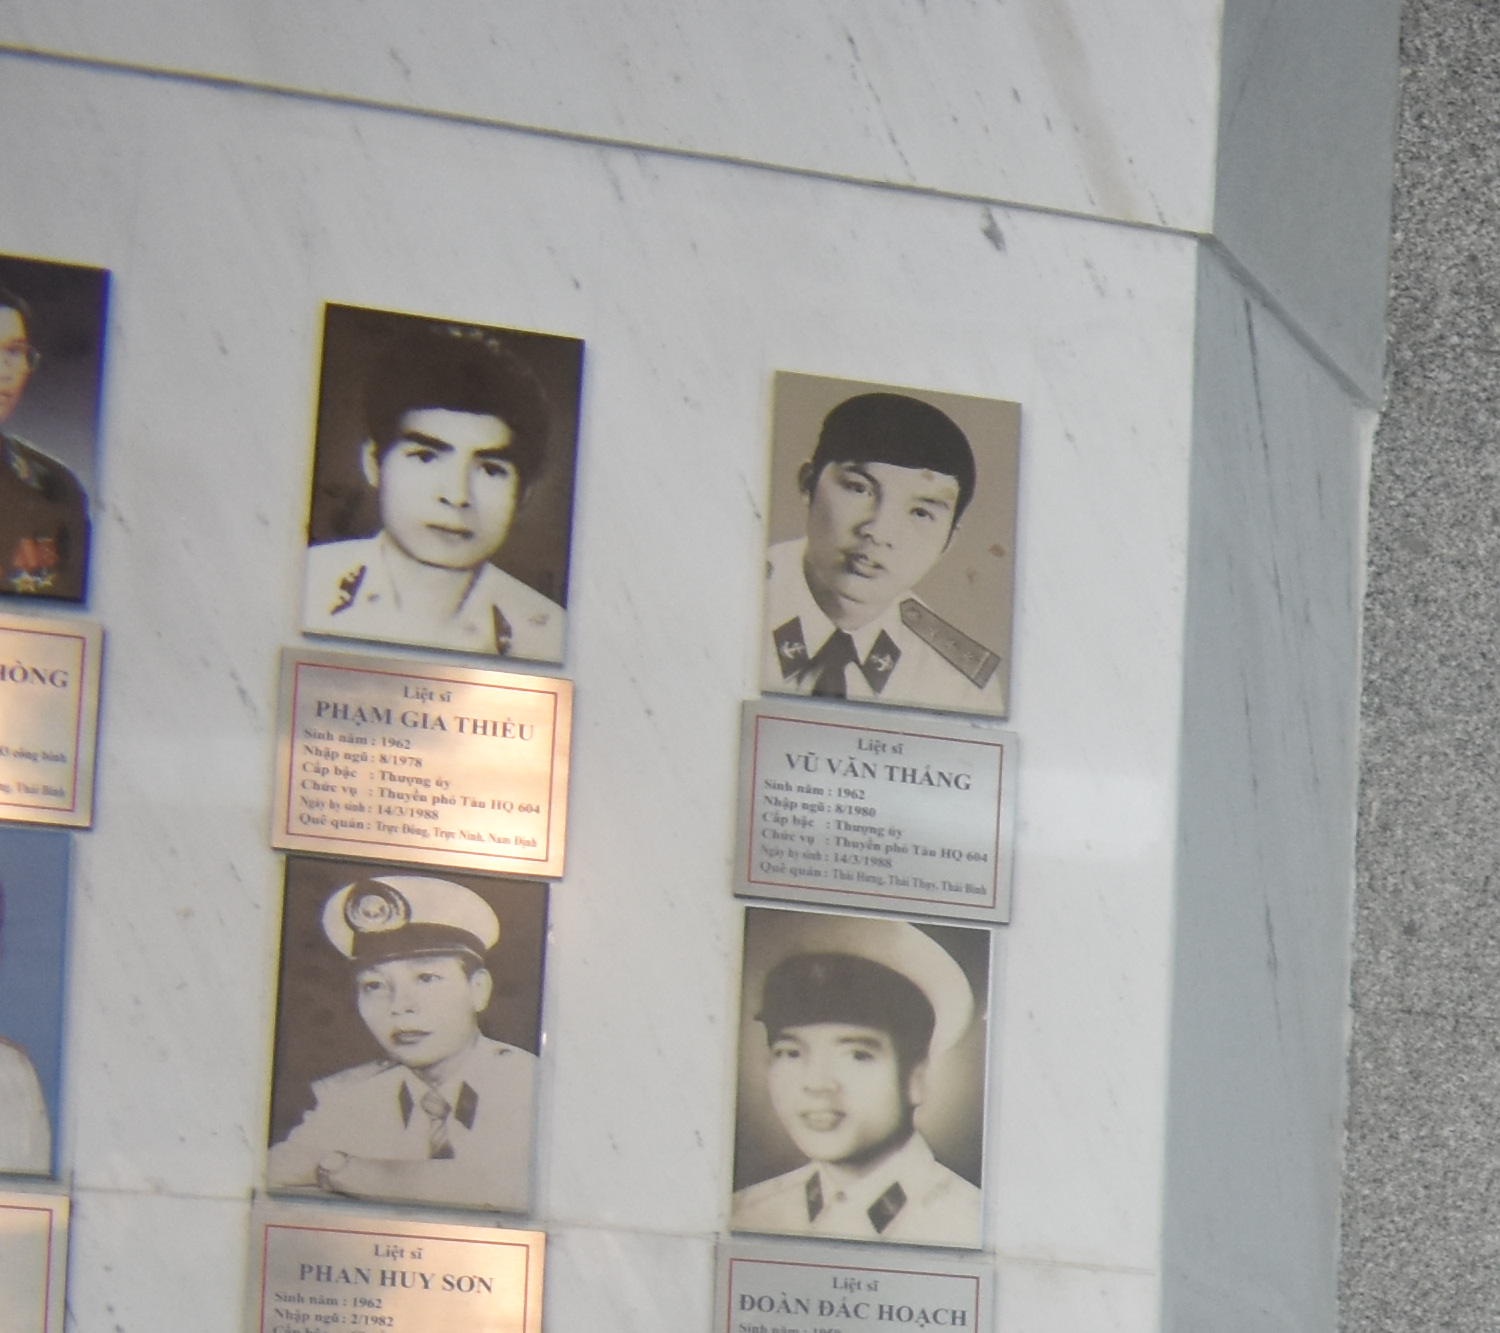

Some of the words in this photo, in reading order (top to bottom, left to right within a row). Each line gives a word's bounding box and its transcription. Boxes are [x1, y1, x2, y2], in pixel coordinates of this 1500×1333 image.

[404, 685, 433, 702] Liệt
[439, 691, 452, 702] sĩ
[315, 700, 392, 727] PHẠM
[400, 710, 447, 731] GIA
[454, 716, 535, 741] THIỀU
[381, 737, 412, 750] 1962
[858, 738, 887, 754] Liệt
[892, 742, 903, 755] sĩ
[379, 753, 423, 768] 8/1978
[786, 752, 818, 773] VŨ
[827, 756, 877, 778] VĂN
[837, 787, 865, 800] 1962
[377, 805, 440, 820] 14/3/1988
[374, 1244, 404, 1260] Liệt
[410, 1248, 422, 1260] sĩ
[300, 1263, 371, 1285] PHAN
[380, 1269, 435, 1290] HUY
[442, 1273, 494, 1294] SƠN
[832, 1277, 862, 1293] Liệt
[867, 1280, 878, 1291] sĩ
[352, 1295, 382, 1309] 1962
[739, 1291, 810, 1315] ĐOÀN
[878, 1303, 967, 1328] HOẠCH
[350, 1313, 394, 1327] 2/1982
